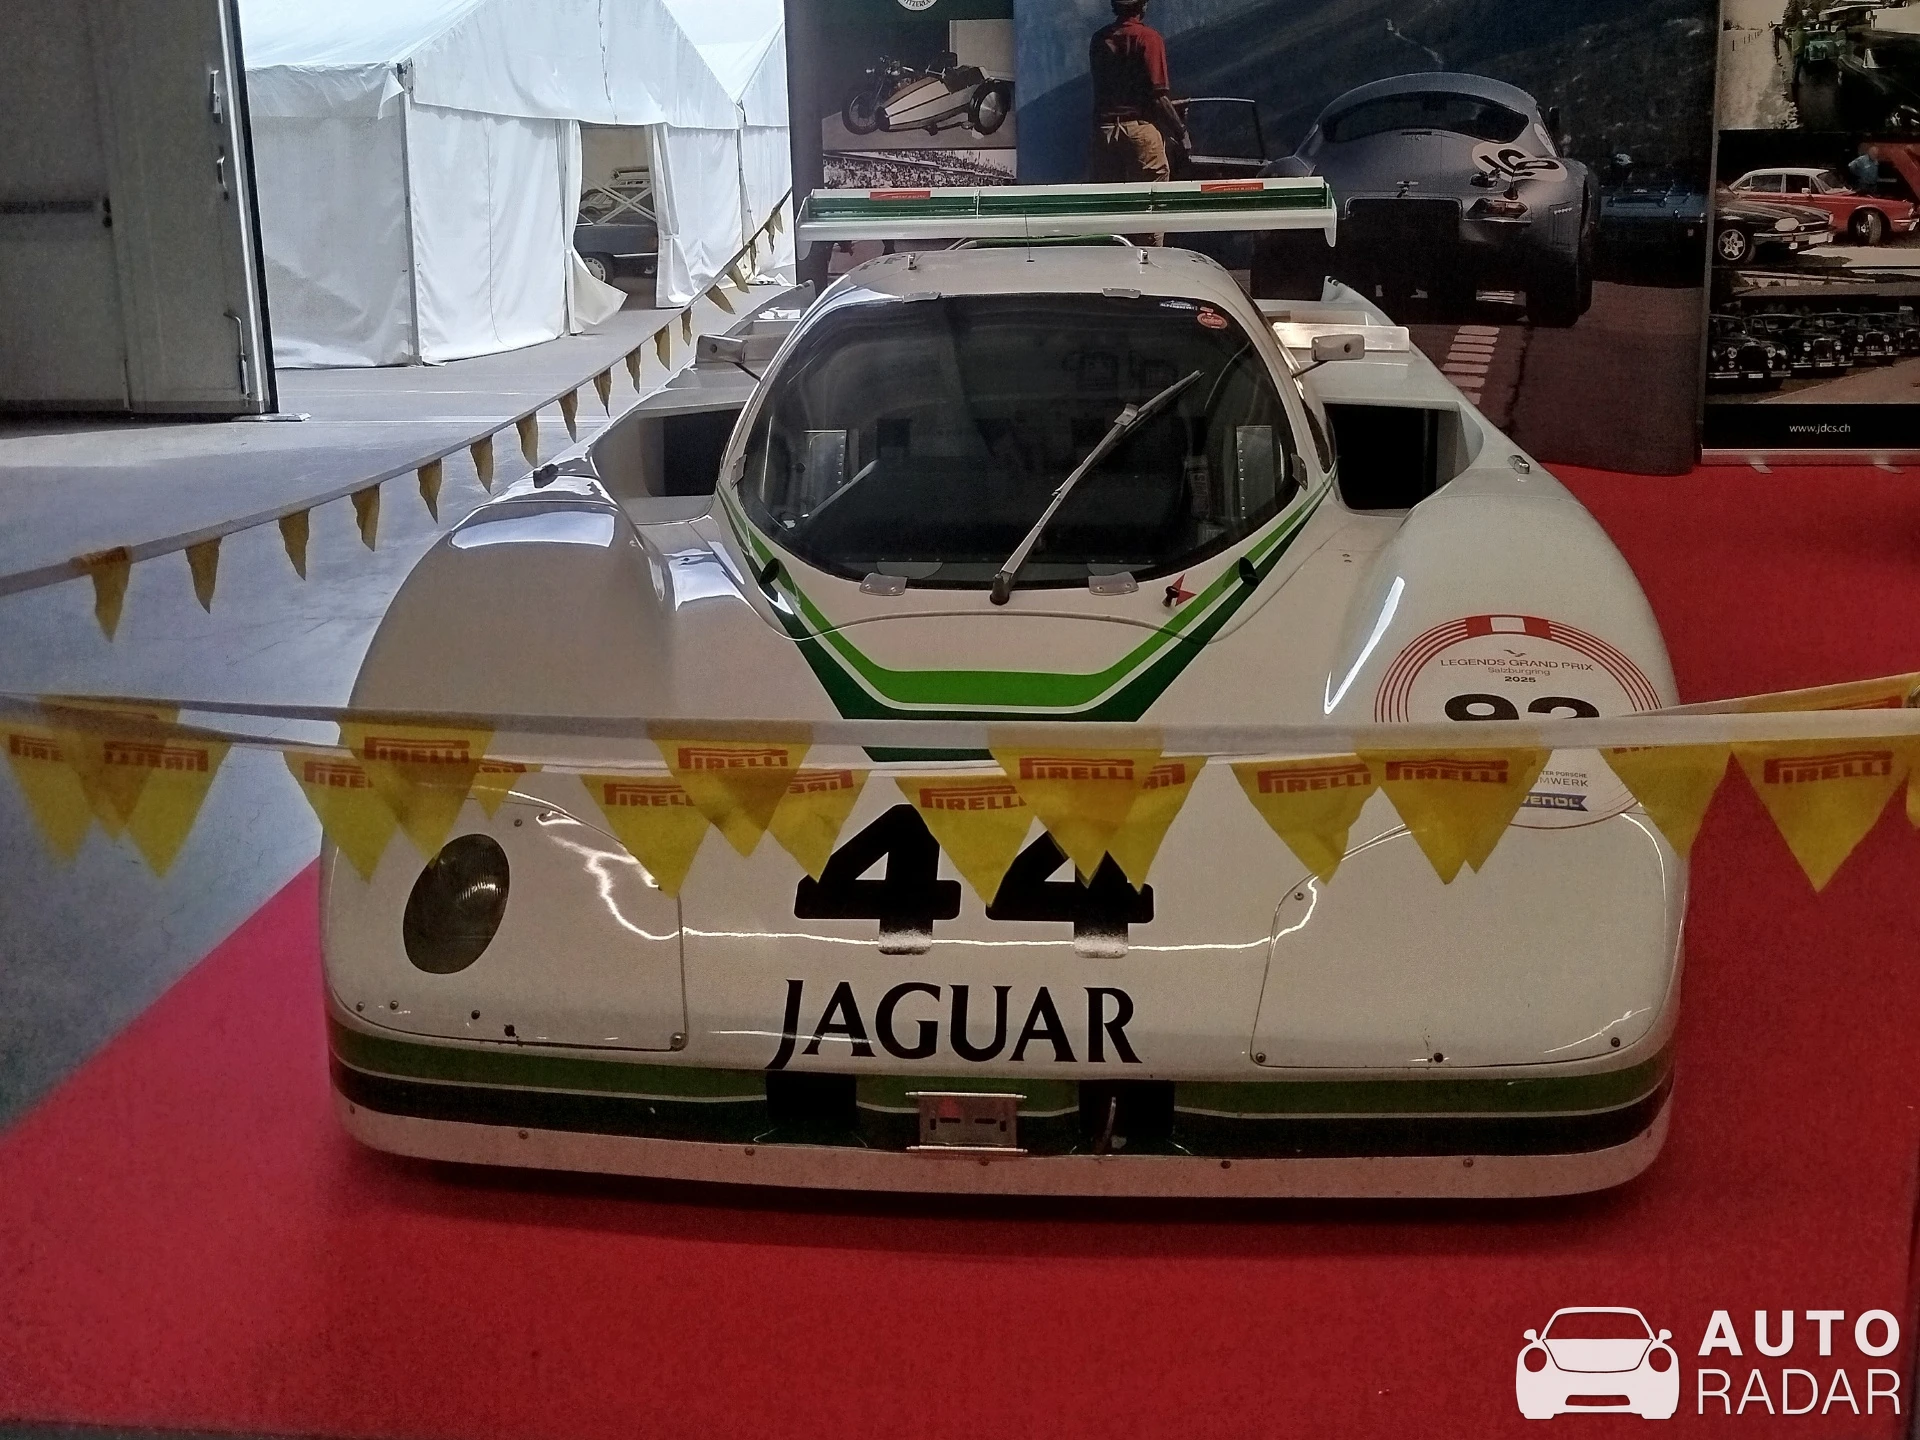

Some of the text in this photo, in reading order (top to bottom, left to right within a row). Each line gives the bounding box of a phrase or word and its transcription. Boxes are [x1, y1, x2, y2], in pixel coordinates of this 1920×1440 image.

[1789, 423, 1851, 435] www.jdcs.ch
[1440, 658, 1594, 671] LEGENDS GRAND PRIX
[1487, 666, 1551, 676] Salzburgring
[1504, 675, 1537, 683] 2025
[9, 734, 64, 762] PIRE
[365, 737, 471, 764] PIRELLI
[677, 747, 789, 770] PIRELLI
[304, 761, 374, 789] PIRE
[1019, 757, 1135, 780] PIRELLI
[1257, 763, 1372, 794] PIRELLI
[1385, 759, 1509, 784] PIRELLI
[1556, 770, 1588, 778] PORSCHE
[1763, 750, 1894, 784] PIRELLI
[1540, 777, 1589, 787] MWERK
[604, 783, 696, 807] PIREL
[793, 803, 1155, 959] 44
[765, 978, 1143, 1070] JAGUAR
